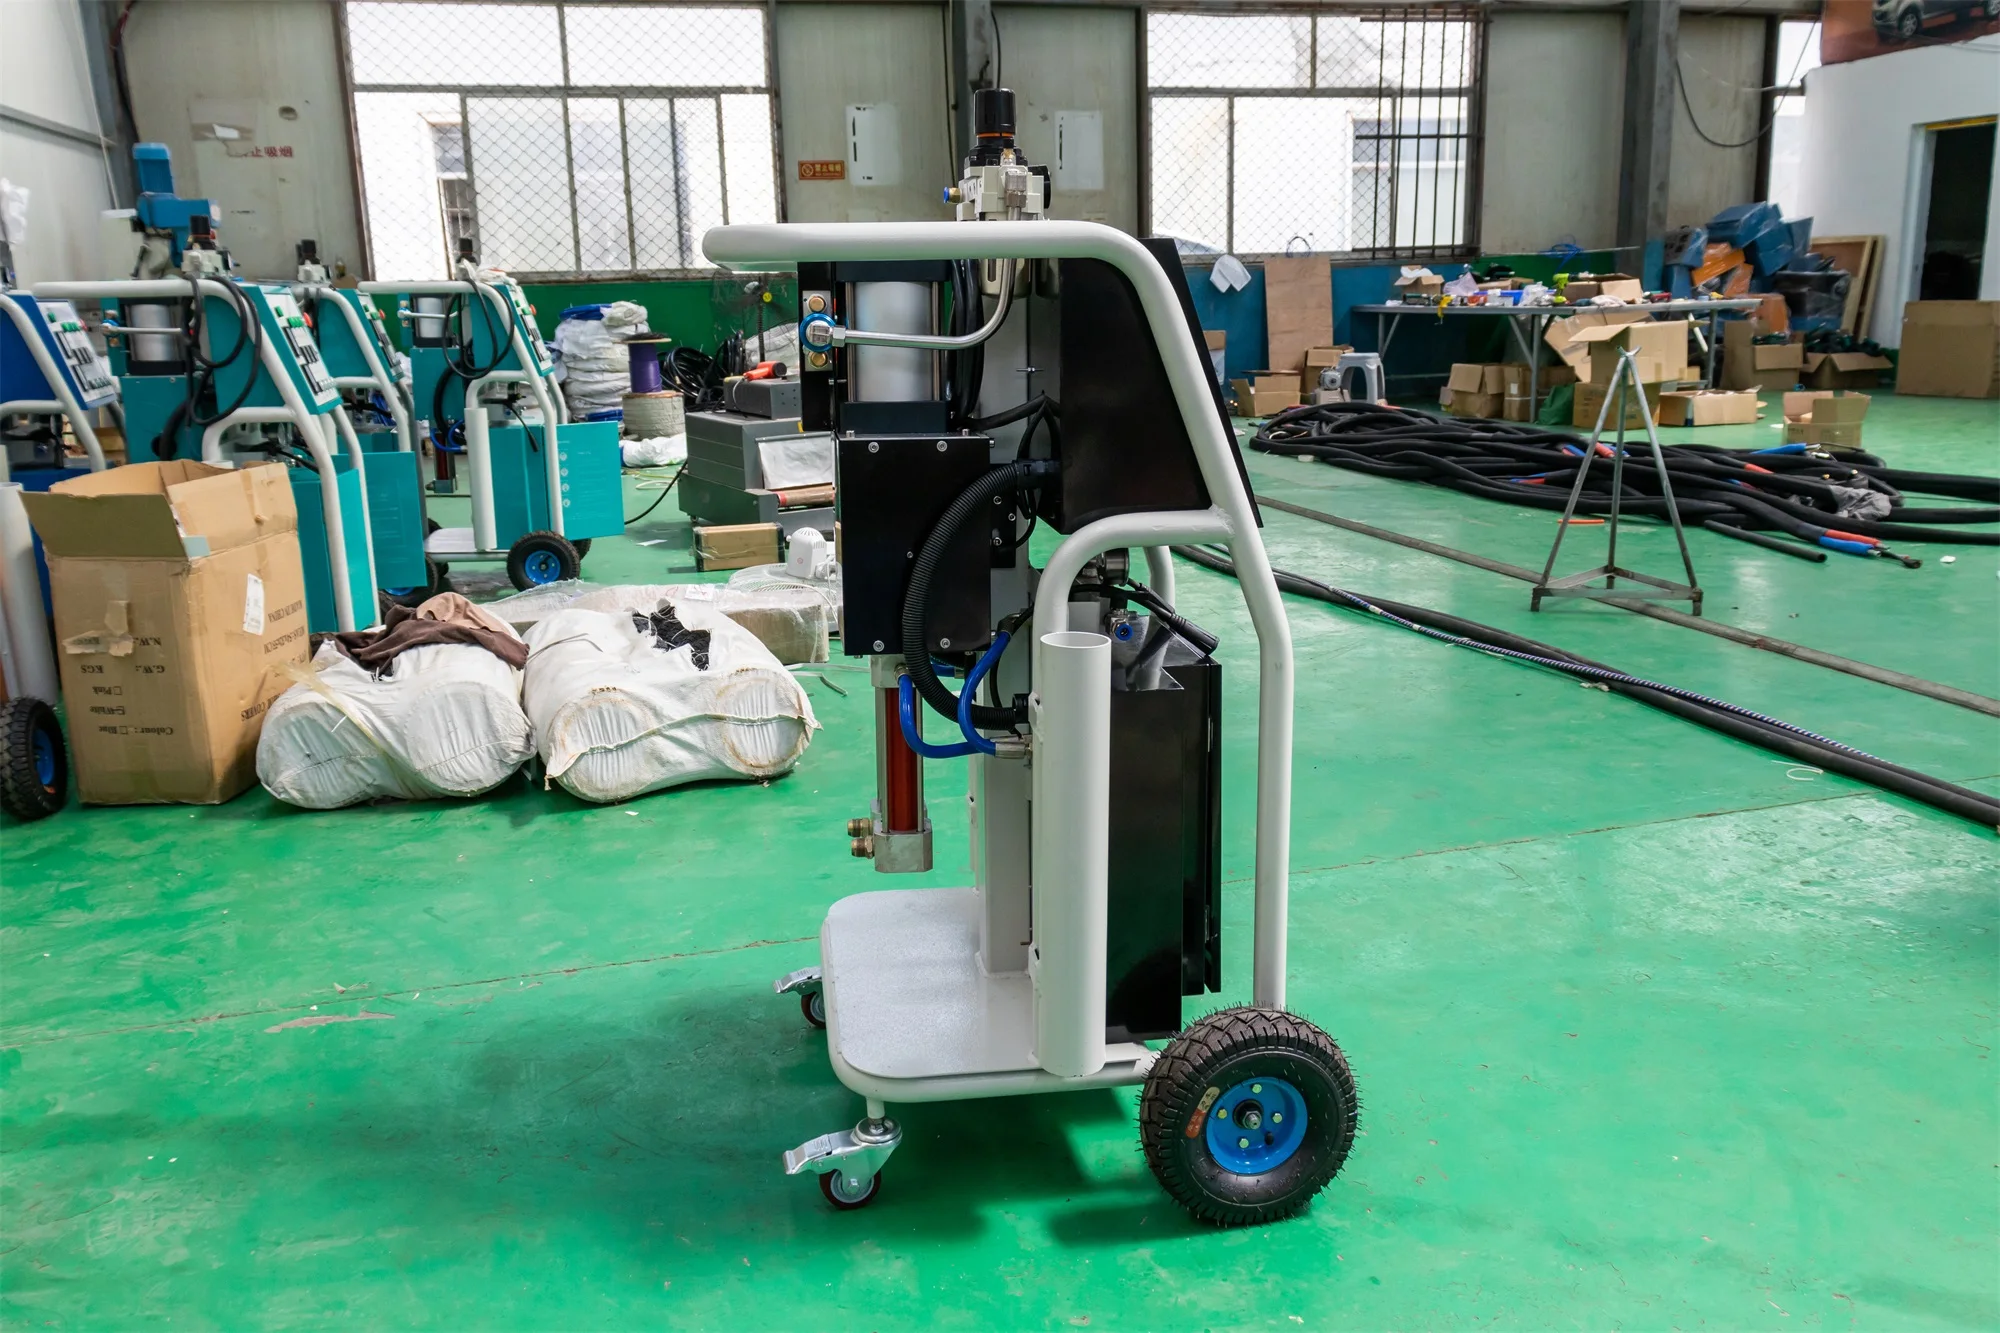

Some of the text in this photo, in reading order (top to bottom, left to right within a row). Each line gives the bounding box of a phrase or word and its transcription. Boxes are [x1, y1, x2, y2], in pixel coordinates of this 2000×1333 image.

[243, 145, 293, 158] 止吸烟
[81, 664, 104, 674] KGS
[92, 686, 112, 695] Pink
[90, 706, 113, 715] White
[99, 726, 117, 735] Blue
